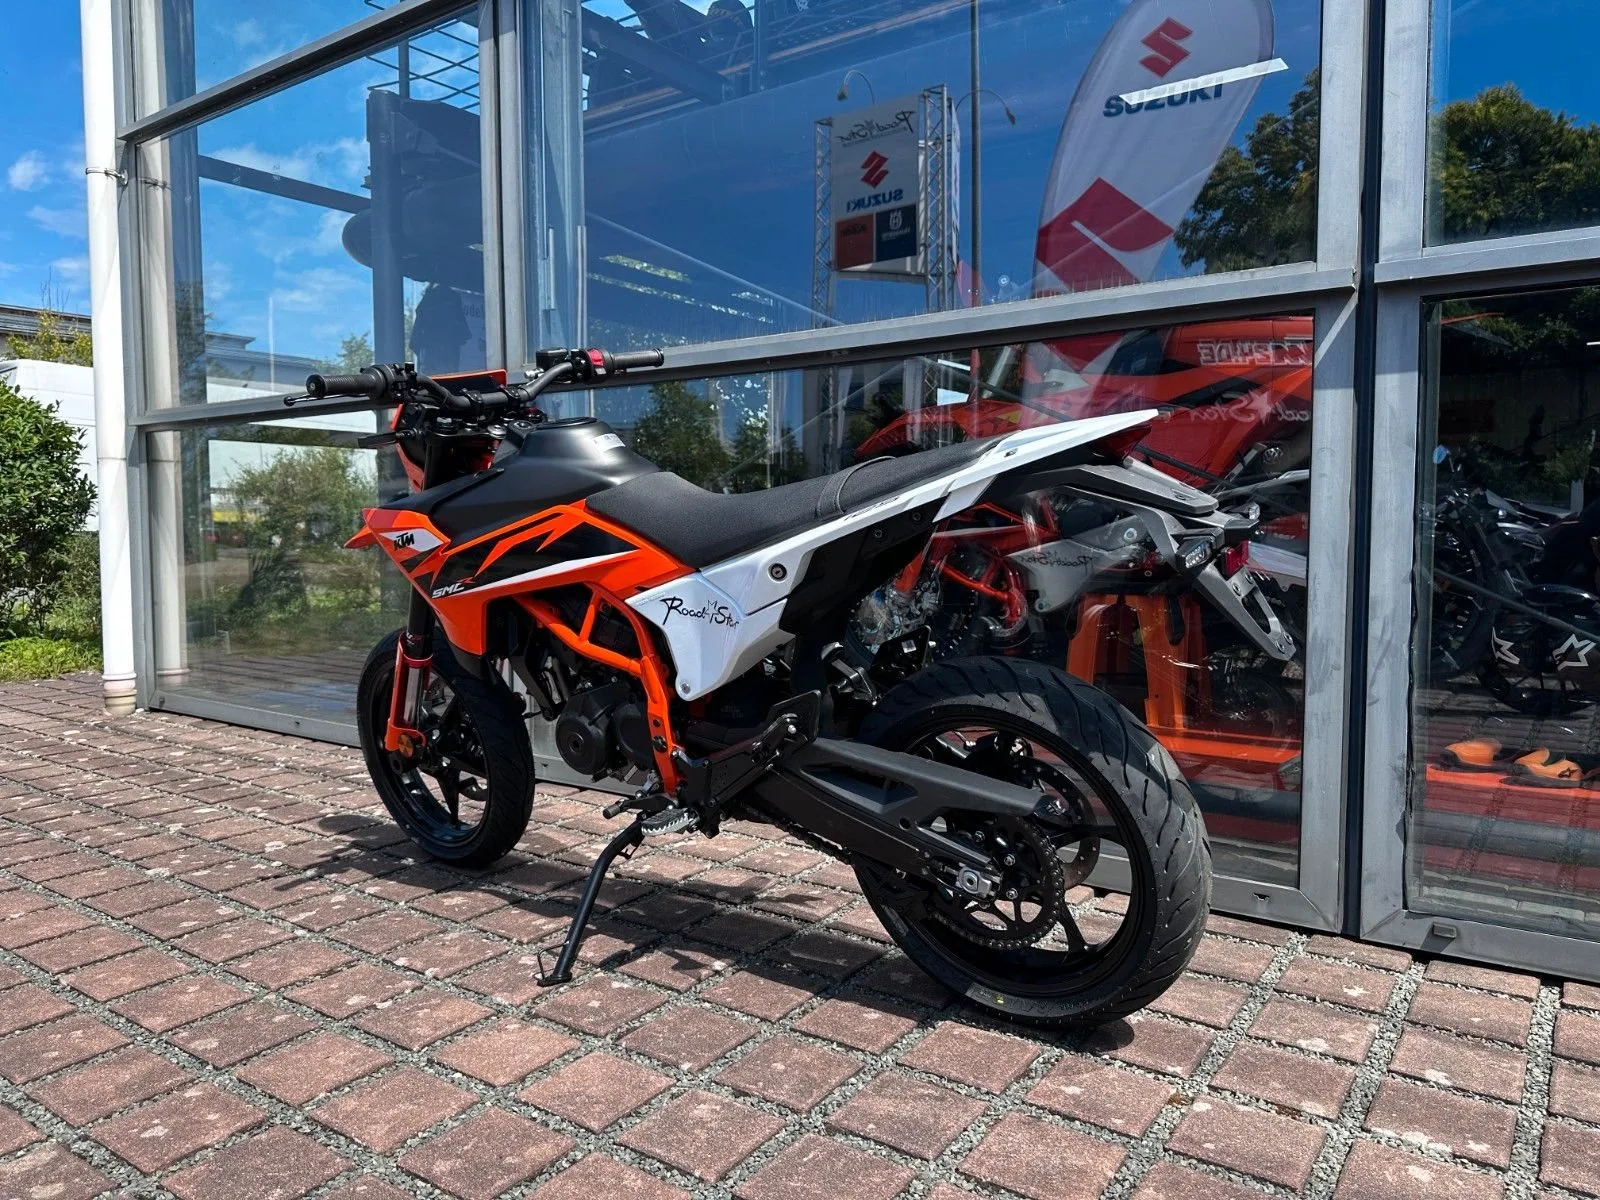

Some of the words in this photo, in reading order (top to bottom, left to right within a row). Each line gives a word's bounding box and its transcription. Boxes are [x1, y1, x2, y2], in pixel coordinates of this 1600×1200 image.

[394, 532, 415, 550] KTM
[432, 582, 465, 599] SMC
[659, 596, 705, 625] Road
